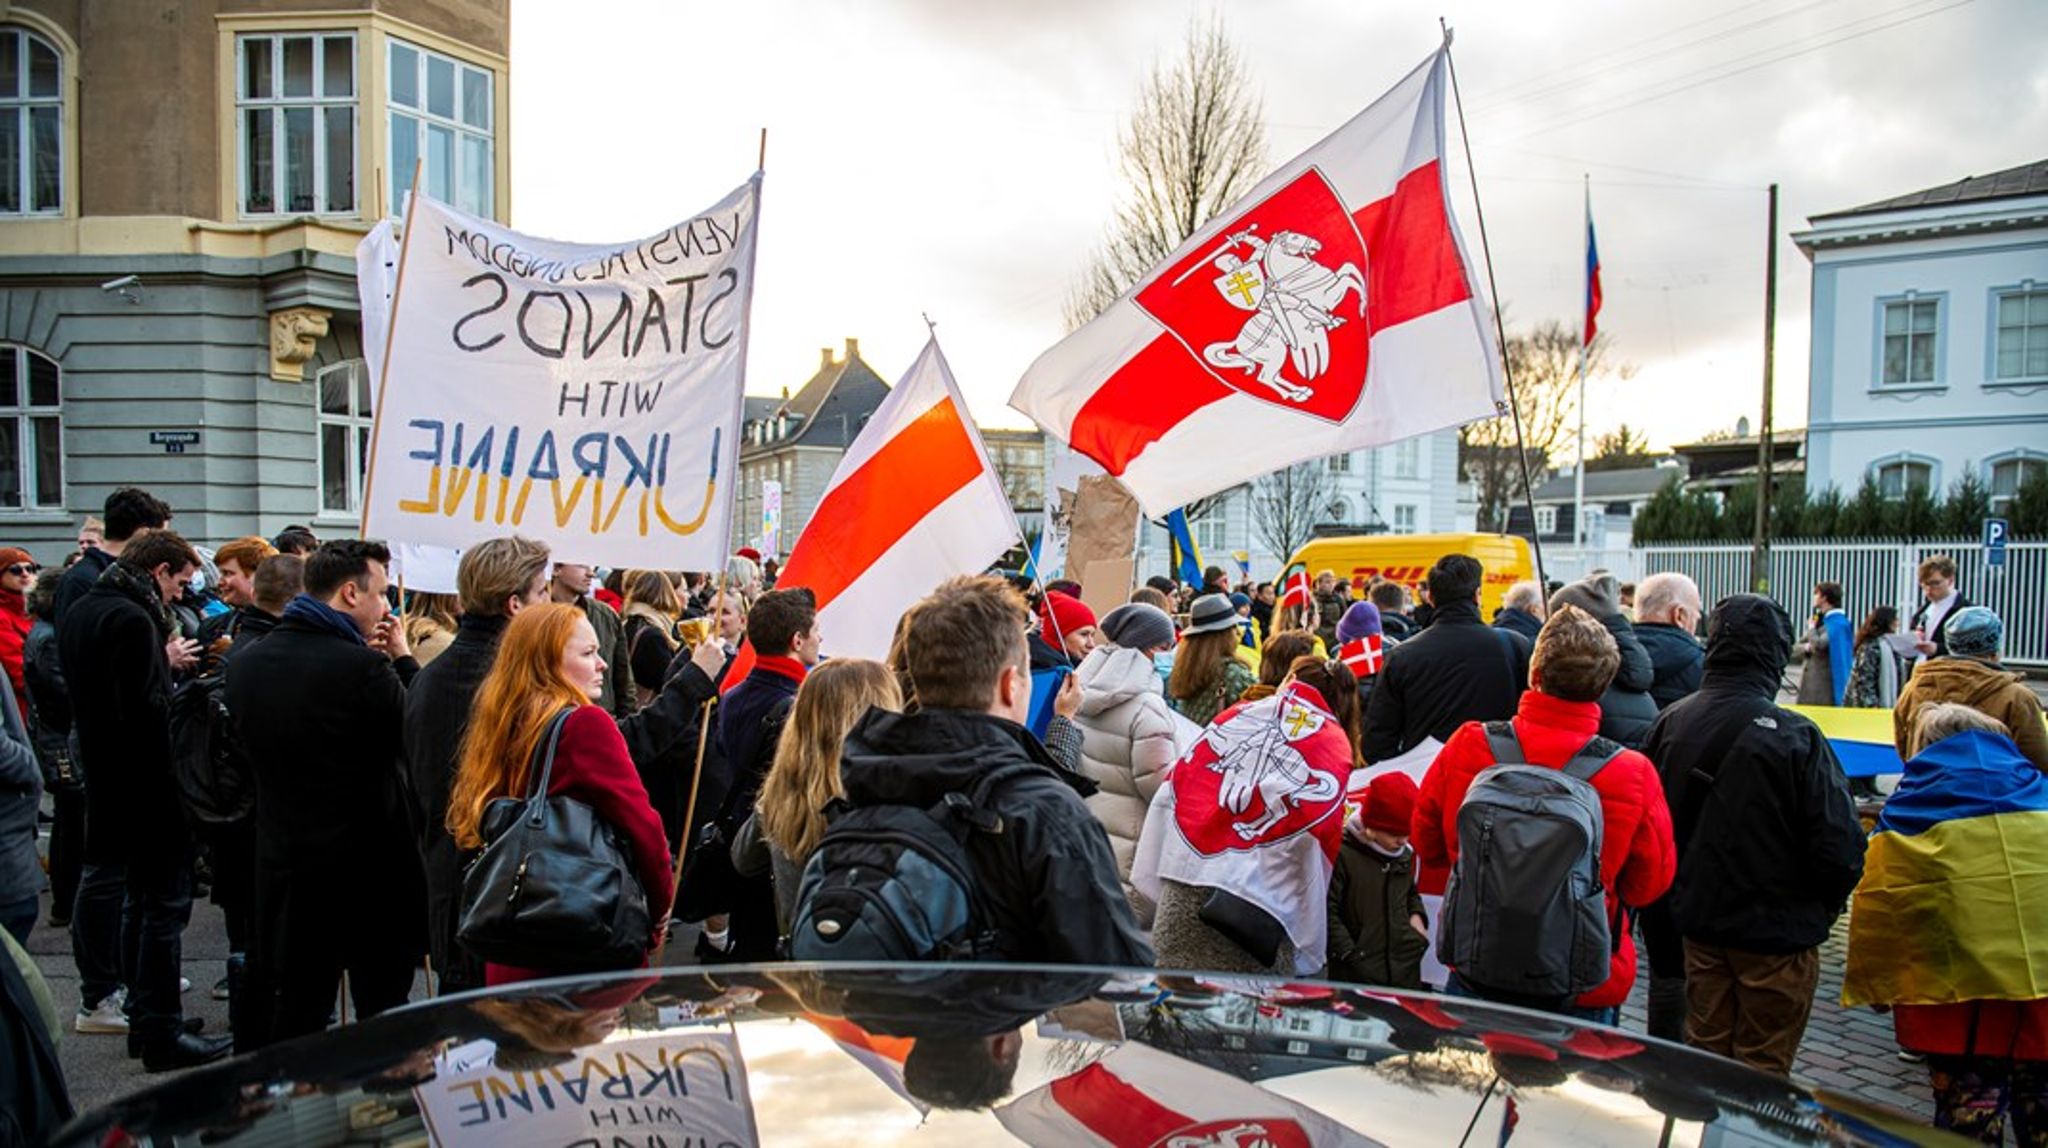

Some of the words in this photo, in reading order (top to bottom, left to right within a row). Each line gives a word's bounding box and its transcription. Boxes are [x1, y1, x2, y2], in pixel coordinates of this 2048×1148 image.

[1990, 523, 2003, 545] P
[447, 1046, 734, 1127] UKRAINE
[590, 1105, 683, 1127] WITH
